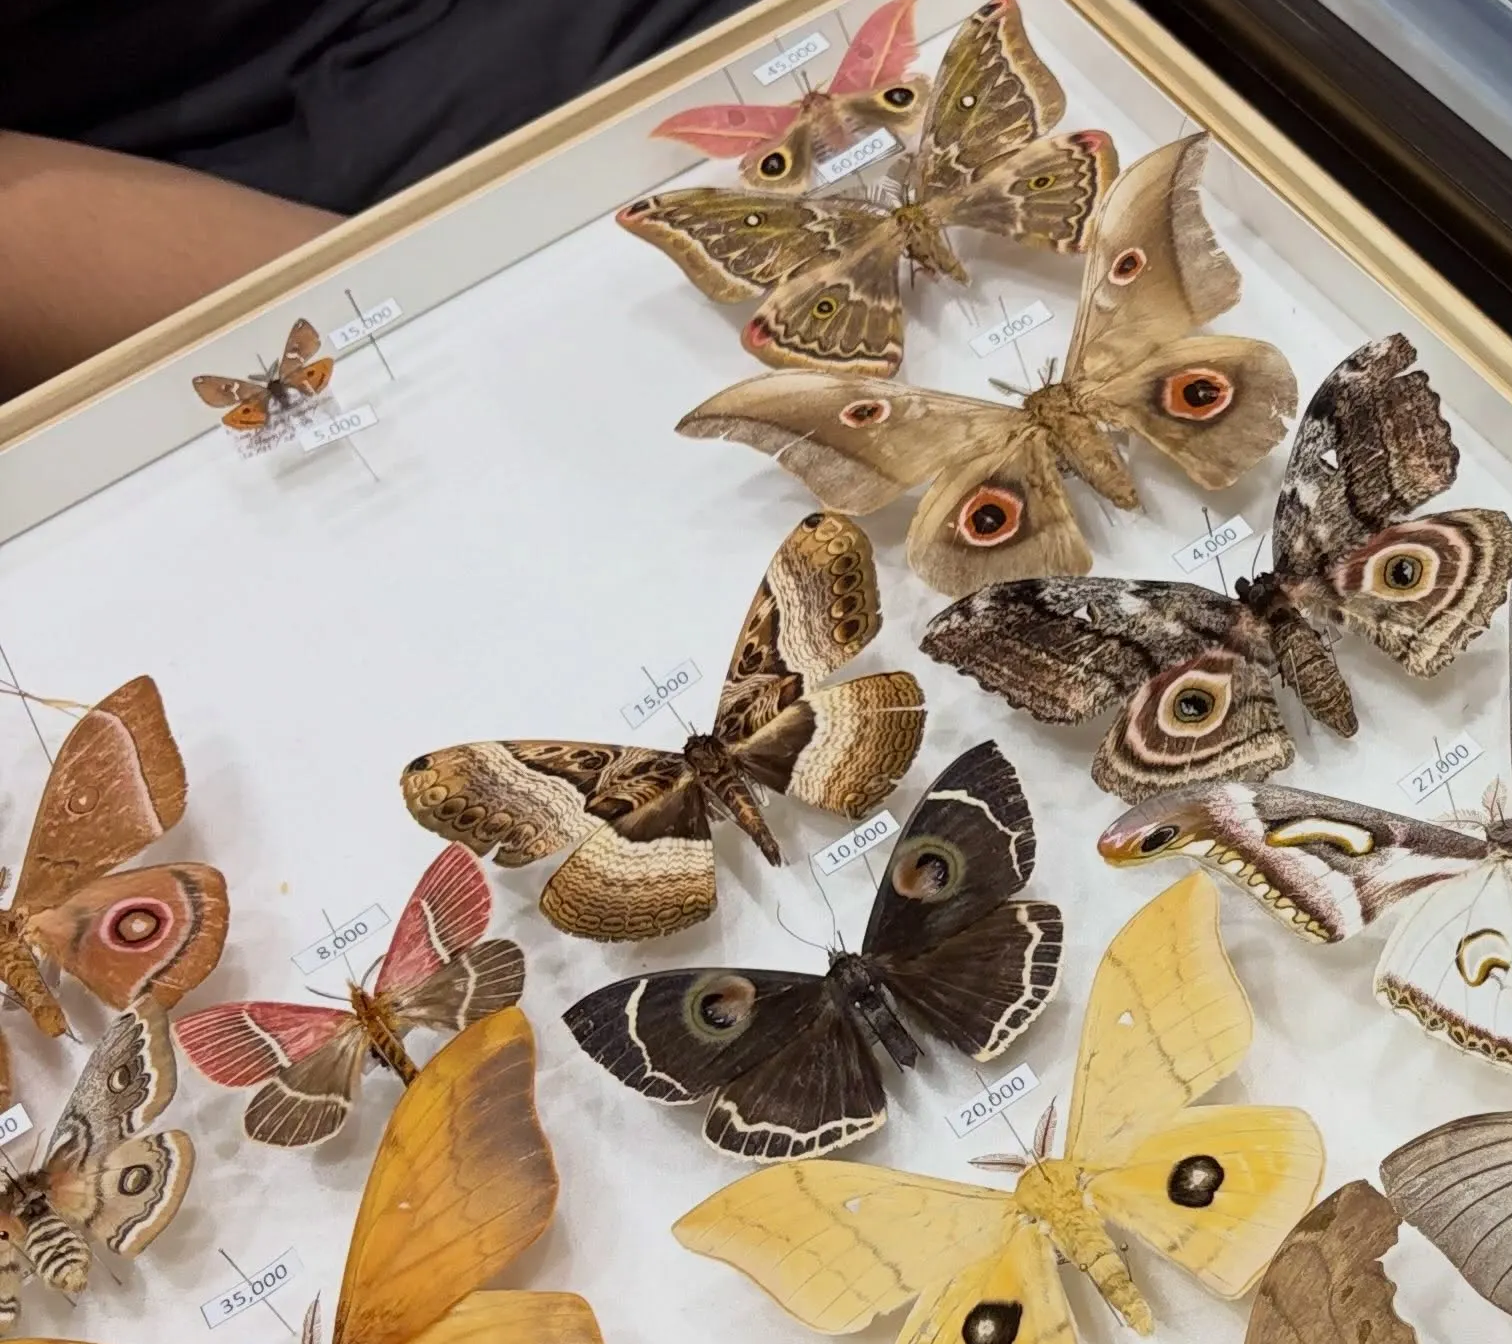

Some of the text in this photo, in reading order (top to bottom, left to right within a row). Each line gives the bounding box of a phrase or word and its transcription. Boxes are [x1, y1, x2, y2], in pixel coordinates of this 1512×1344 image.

[831, 138, 884, 175] 60,000
[338, 306, 393, 342] 15,000
[987, 313, 1034, 345] 9,000
[313, 413, 362, 442] 5,000
[1192, 527, 1237, 561] 4,000
[633, 670, 689, 717] 15,000
[1411, 743, 1470, 793] 27,000
[826, 820, 888, 866] 10,000
[315, 921, 369, 960] 8,000
[959, 1075, 1026, 1126] 20,000
[219, 1263, 288, 1315] 35,000
